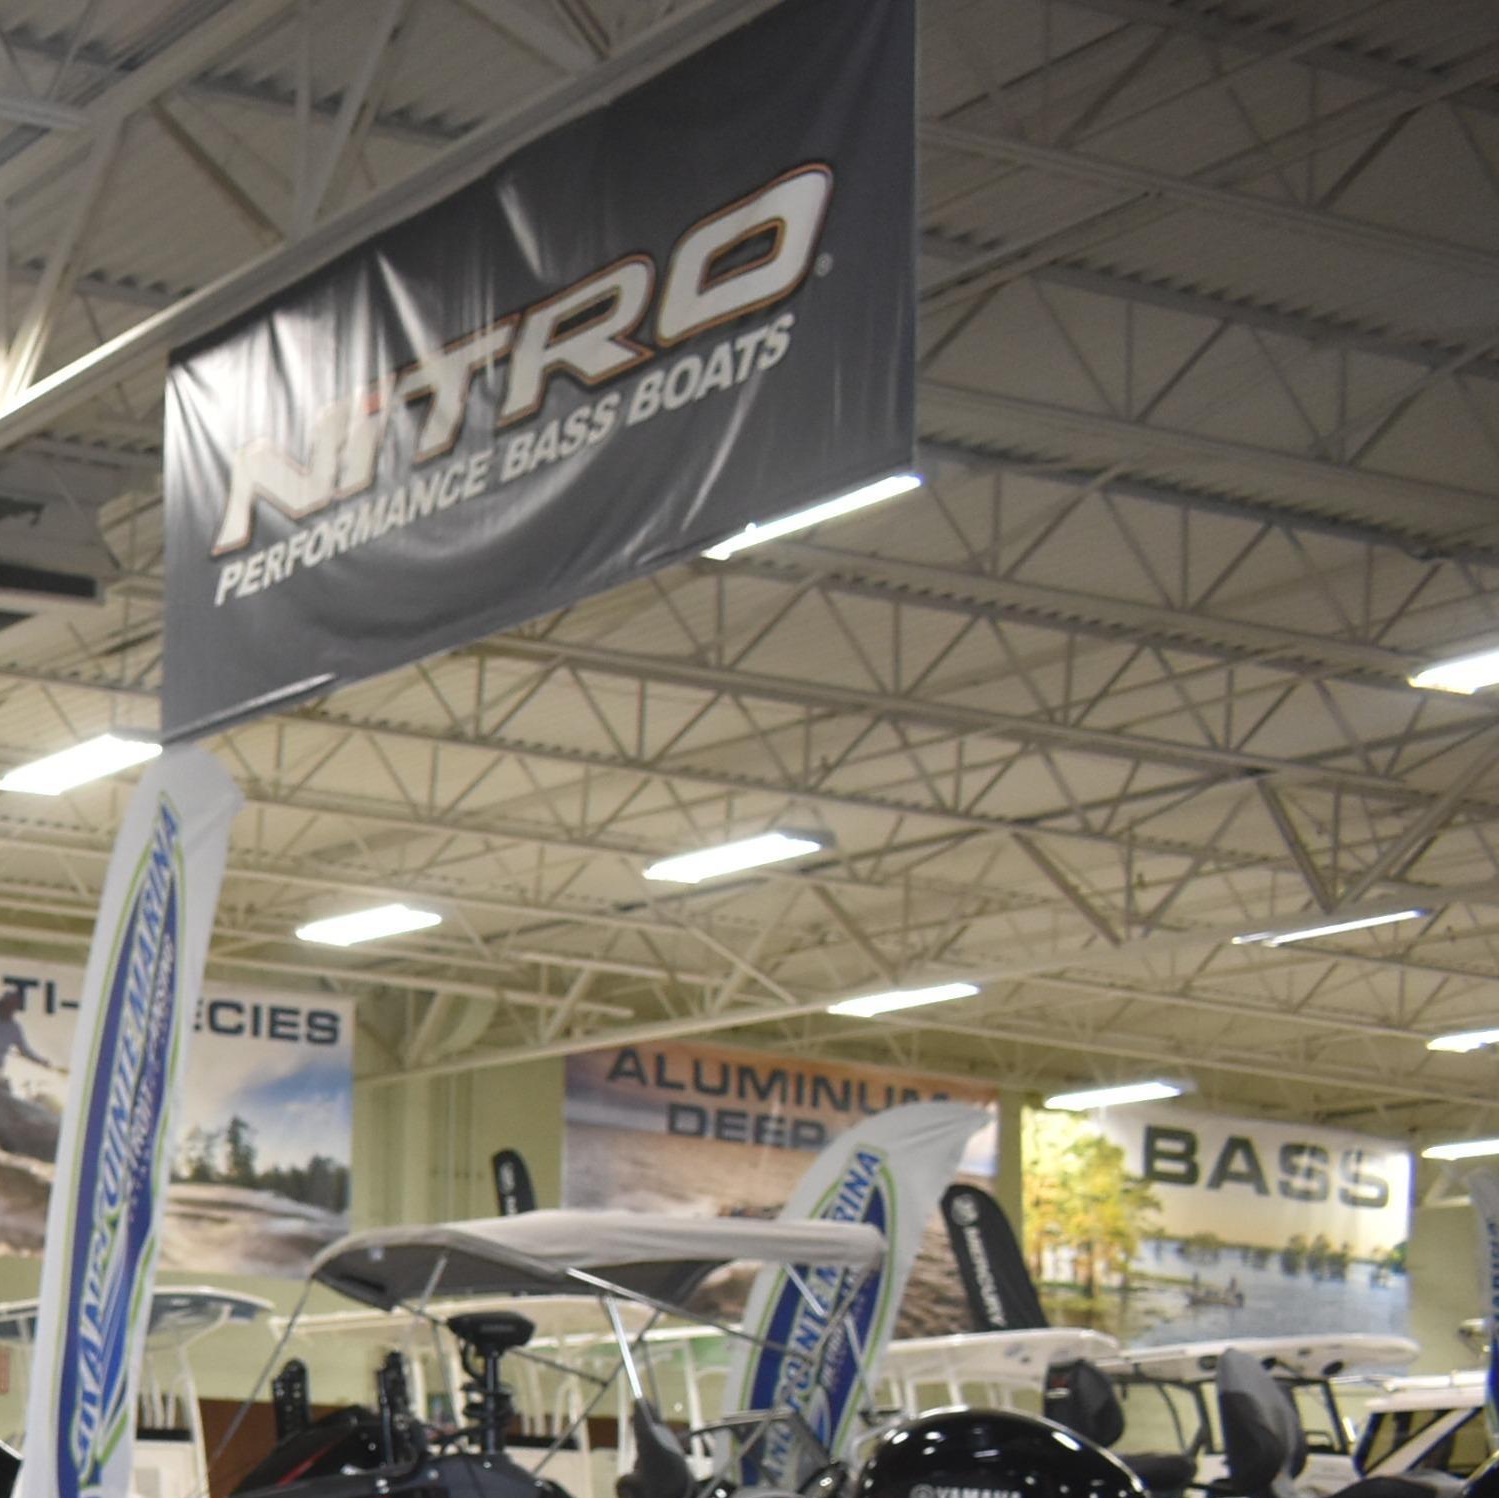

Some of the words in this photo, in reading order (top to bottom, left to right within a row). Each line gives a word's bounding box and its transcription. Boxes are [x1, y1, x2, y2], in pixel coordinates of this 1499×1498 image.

[210, 162, 836, 556] NITRO
[215, 450, 493, 606] PERFORMANCE
[501, 392, 620, 482] BASS
[628, 313, 796, 428] BOATS
[1144, 1125, 1389, 1209] BASS
